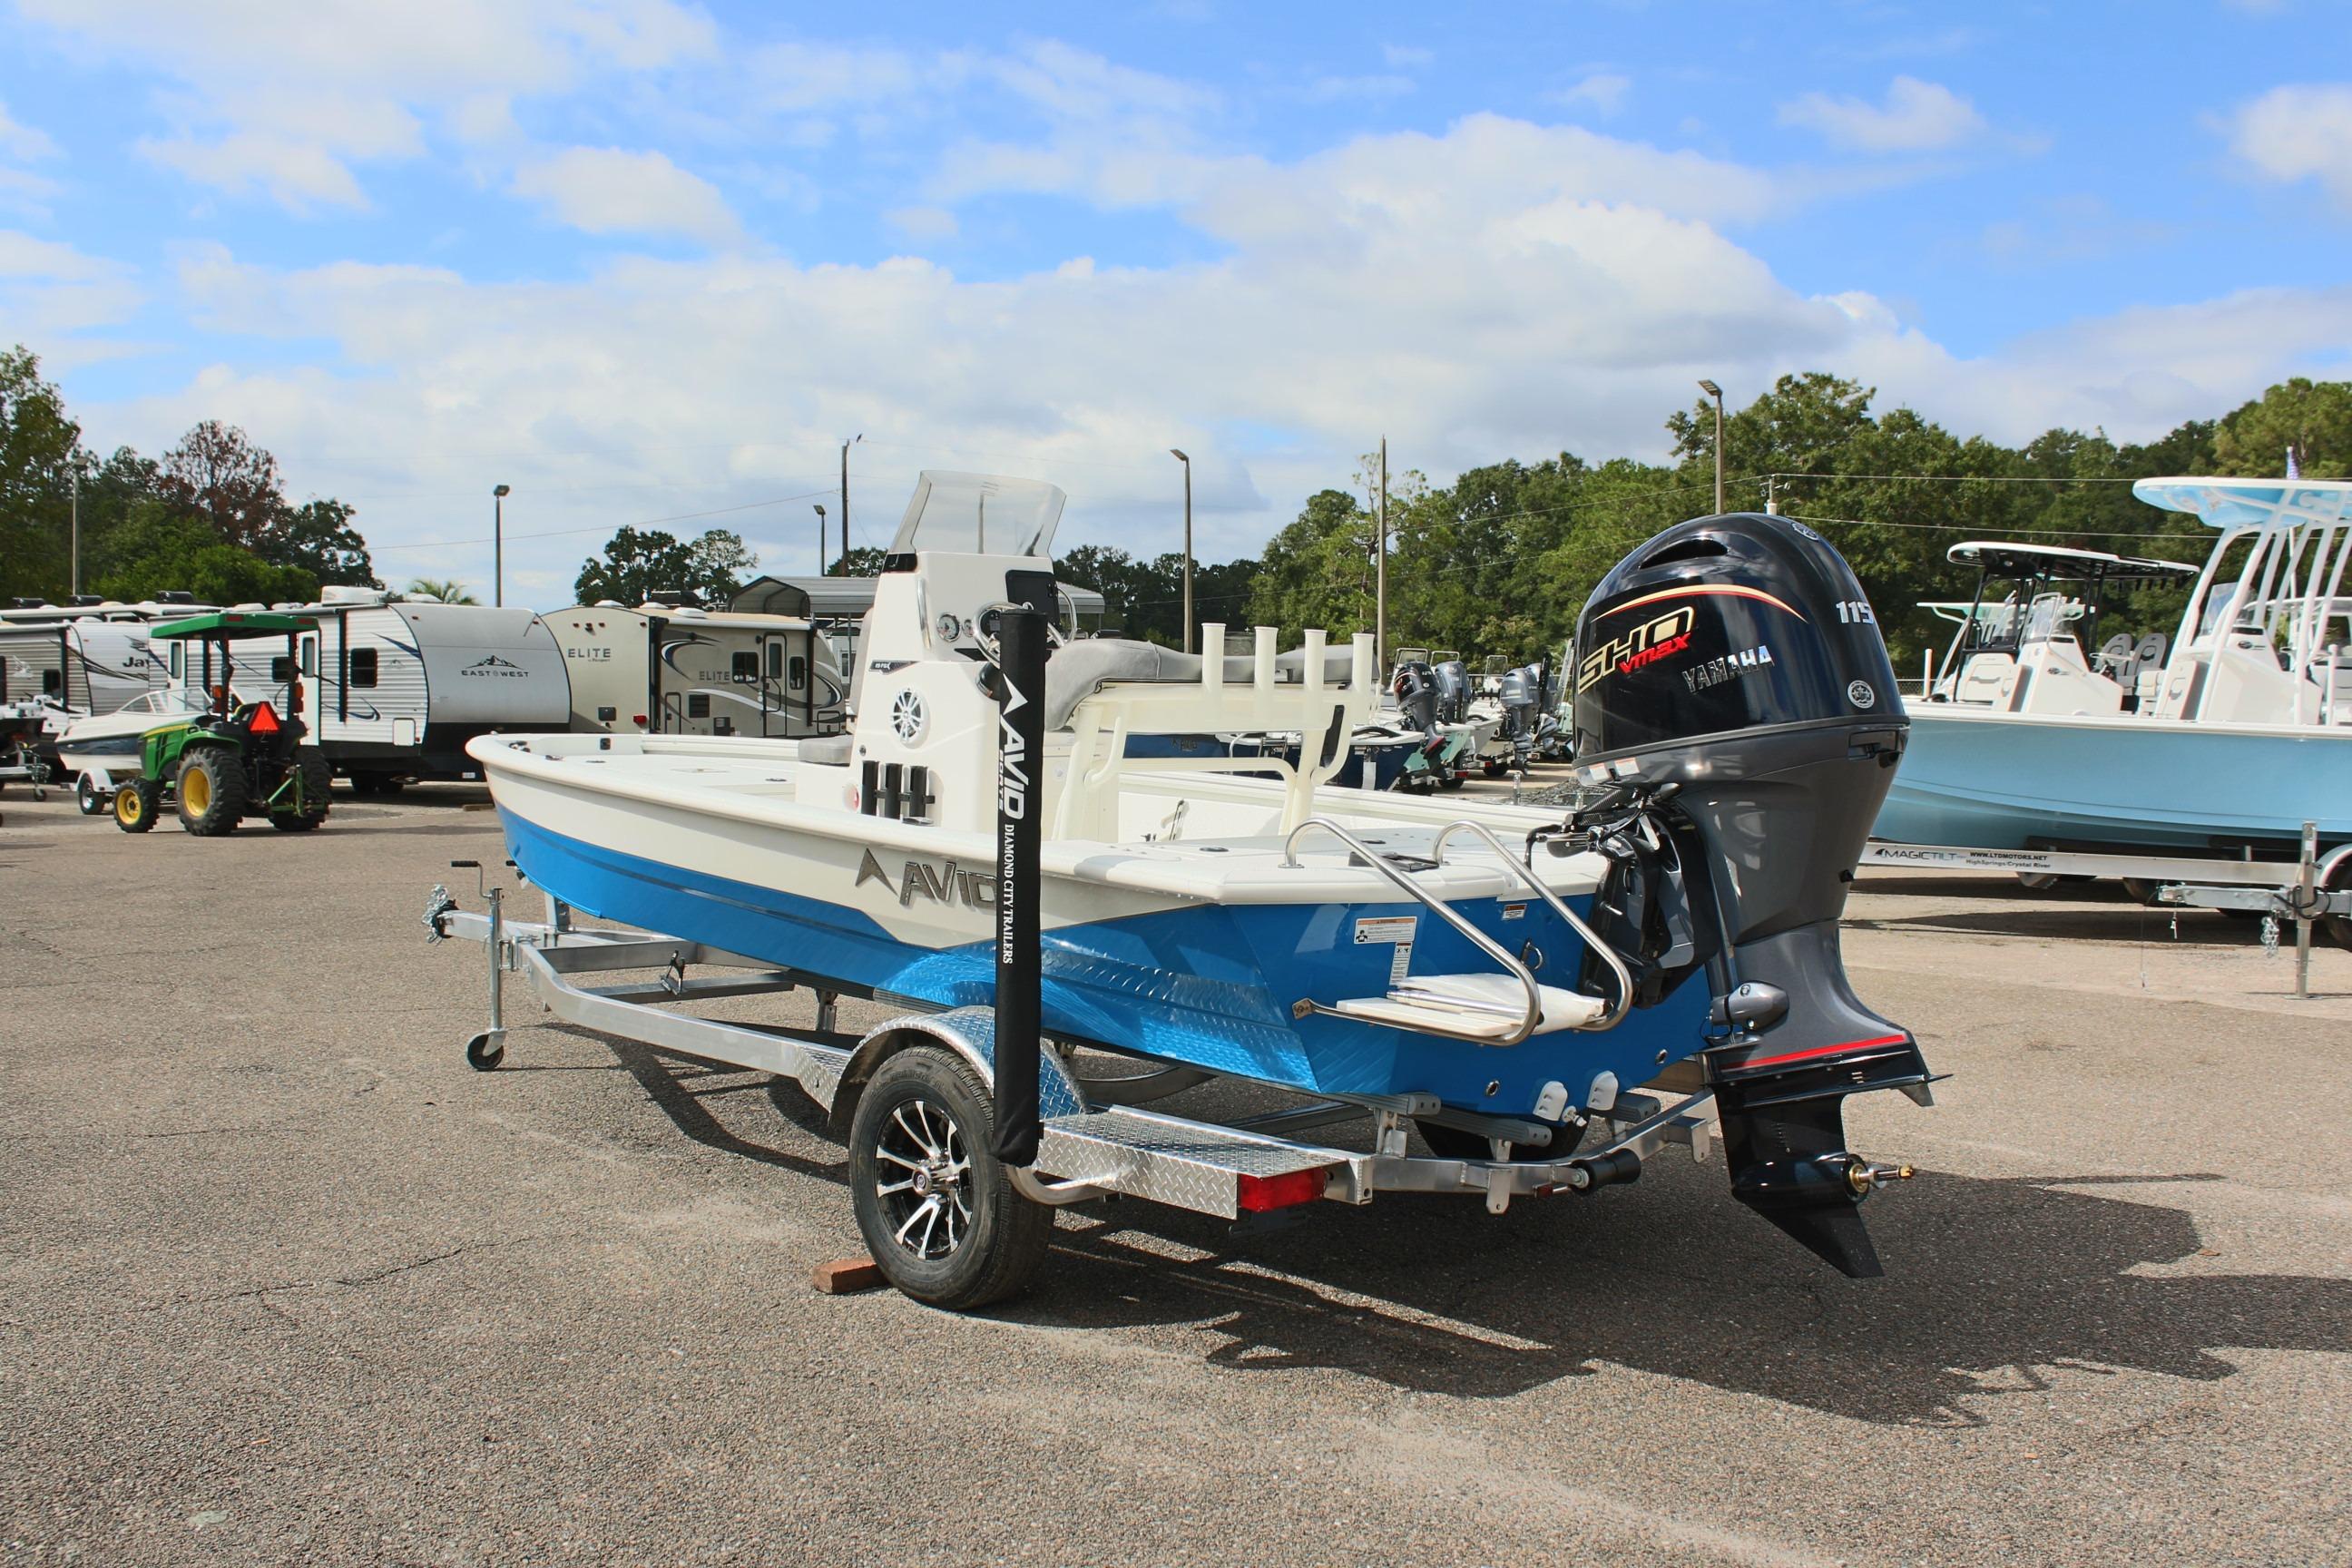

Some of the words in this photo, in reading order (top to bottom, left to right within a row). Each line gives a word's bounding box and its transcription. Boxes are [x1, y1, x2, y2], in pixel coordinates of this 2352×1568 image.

[1836, 601, 1874, 623] 115
[568, 648, 612, 658] ELITE
[1578, 606, 1694, 694] SHO
[1682, 645, 1775, 694] YAMAHA
[699, 671, 730, 681] ELITE
[1000, 713, 1029, 820] AVID
[1004, 823, 1014, 878] DIAMOND
[900, 861, 998, 910] AVID
[1004, 880, 1014, 907] CITY
[1003, 909, 1014, 965] TRAILERS
